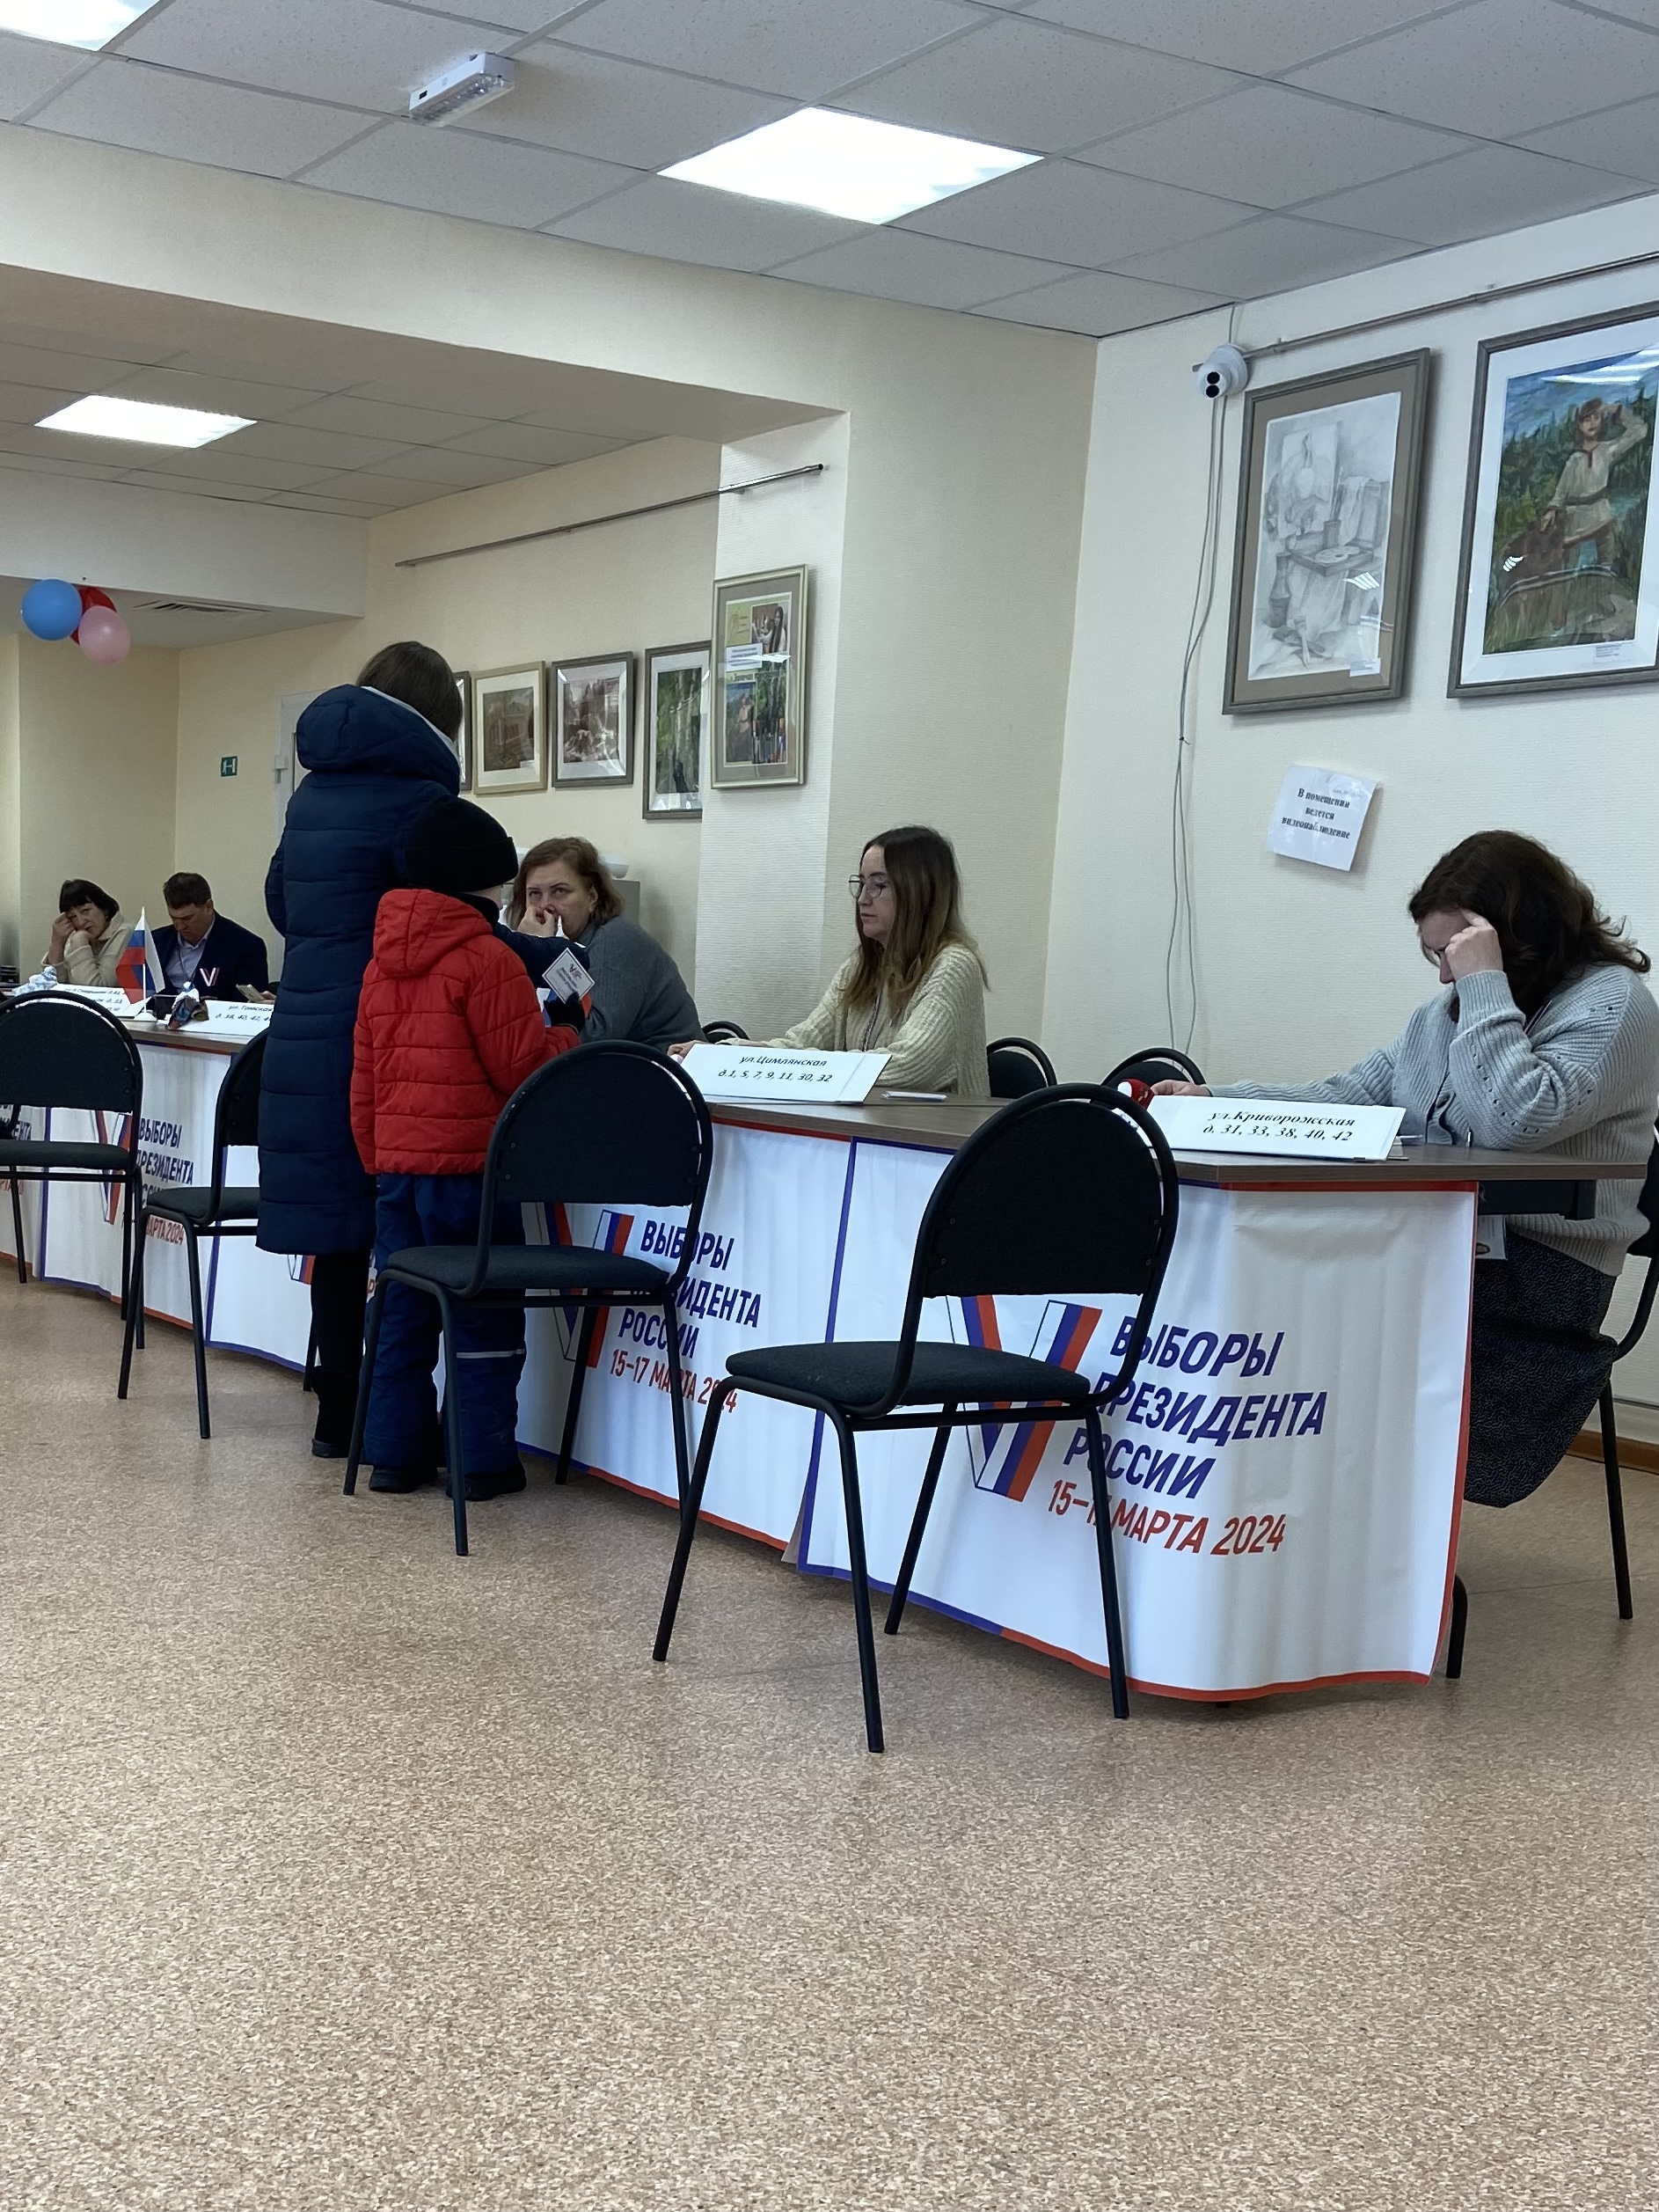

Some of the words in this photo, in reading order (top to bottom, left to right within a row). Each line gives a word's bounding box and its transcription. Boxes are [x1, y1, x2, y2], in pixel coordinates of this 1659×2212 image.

[1297, 787, 1305, 798] В
[740, 1070, 749, 1079] 5,
[752, 1071, 763, 1080] 7,
[764, 1071, 775, 1080] 9,
[778, 1072, 793, 1081] 11,
[797, 1073, 814, 1082] 30,
[816, 1073, 833, 1082] 32
[138, 1117, 183, 1149] ВЫБОРЫ
[1207, 1110, 1356, 1127] ул.Криворожская
[1220, 1124, 1243, 1136] 31,
[1247, 1124, 1270, 1138] 33,
[1275, 1126, 1298, 1139] 38,
[1304, 1129, 1326, 1141] 40,
[1332, 1130, 1353, 1142] 42
[673, 1275, 763, 1329] ИДЕНТА
[1109, 1315, 1286, 1379] ВЫБОРЫ
[697, 1376, 739, 1414] 24
[1111, 1498, 1210, 1555] МАРТА
[1210, 1513, 1287, 1556] 2024
